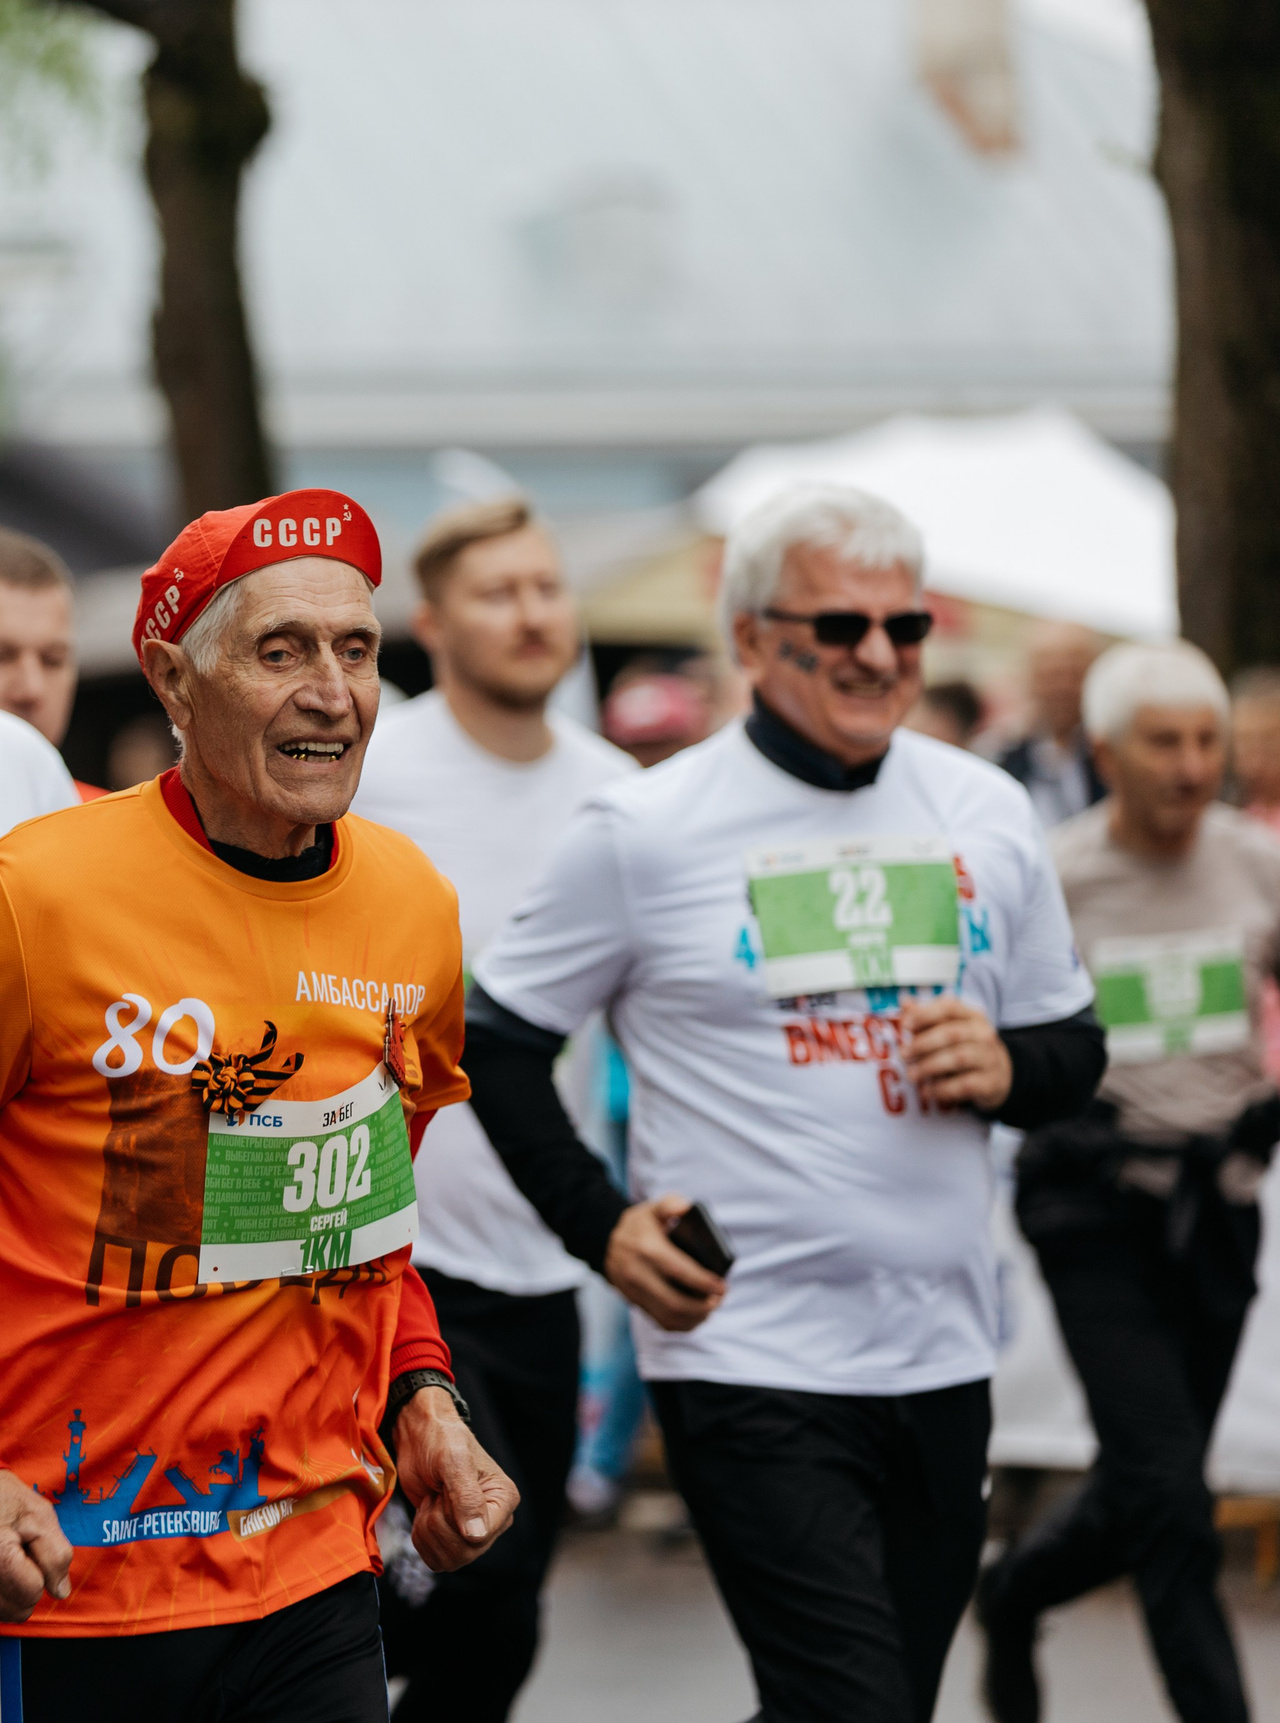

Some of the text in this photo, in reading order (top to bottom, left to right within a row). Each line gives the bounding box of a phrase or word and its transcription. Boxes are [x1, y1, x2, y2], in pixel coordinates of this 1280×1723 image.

[253, 517, 342, 547] СССР
[140, 585, 180, 655] ССР
[827, 867, 893, 929] 22
[296, 971, 426, 1018] АМБАССАДОР
[92, 993, 216, 1078] 80
[250, 1114, 283, 1128] ПСБ
[283, 1124, 371, 1213] 302
[310, 1208, 348, 1232] СЕРГЕЙ
